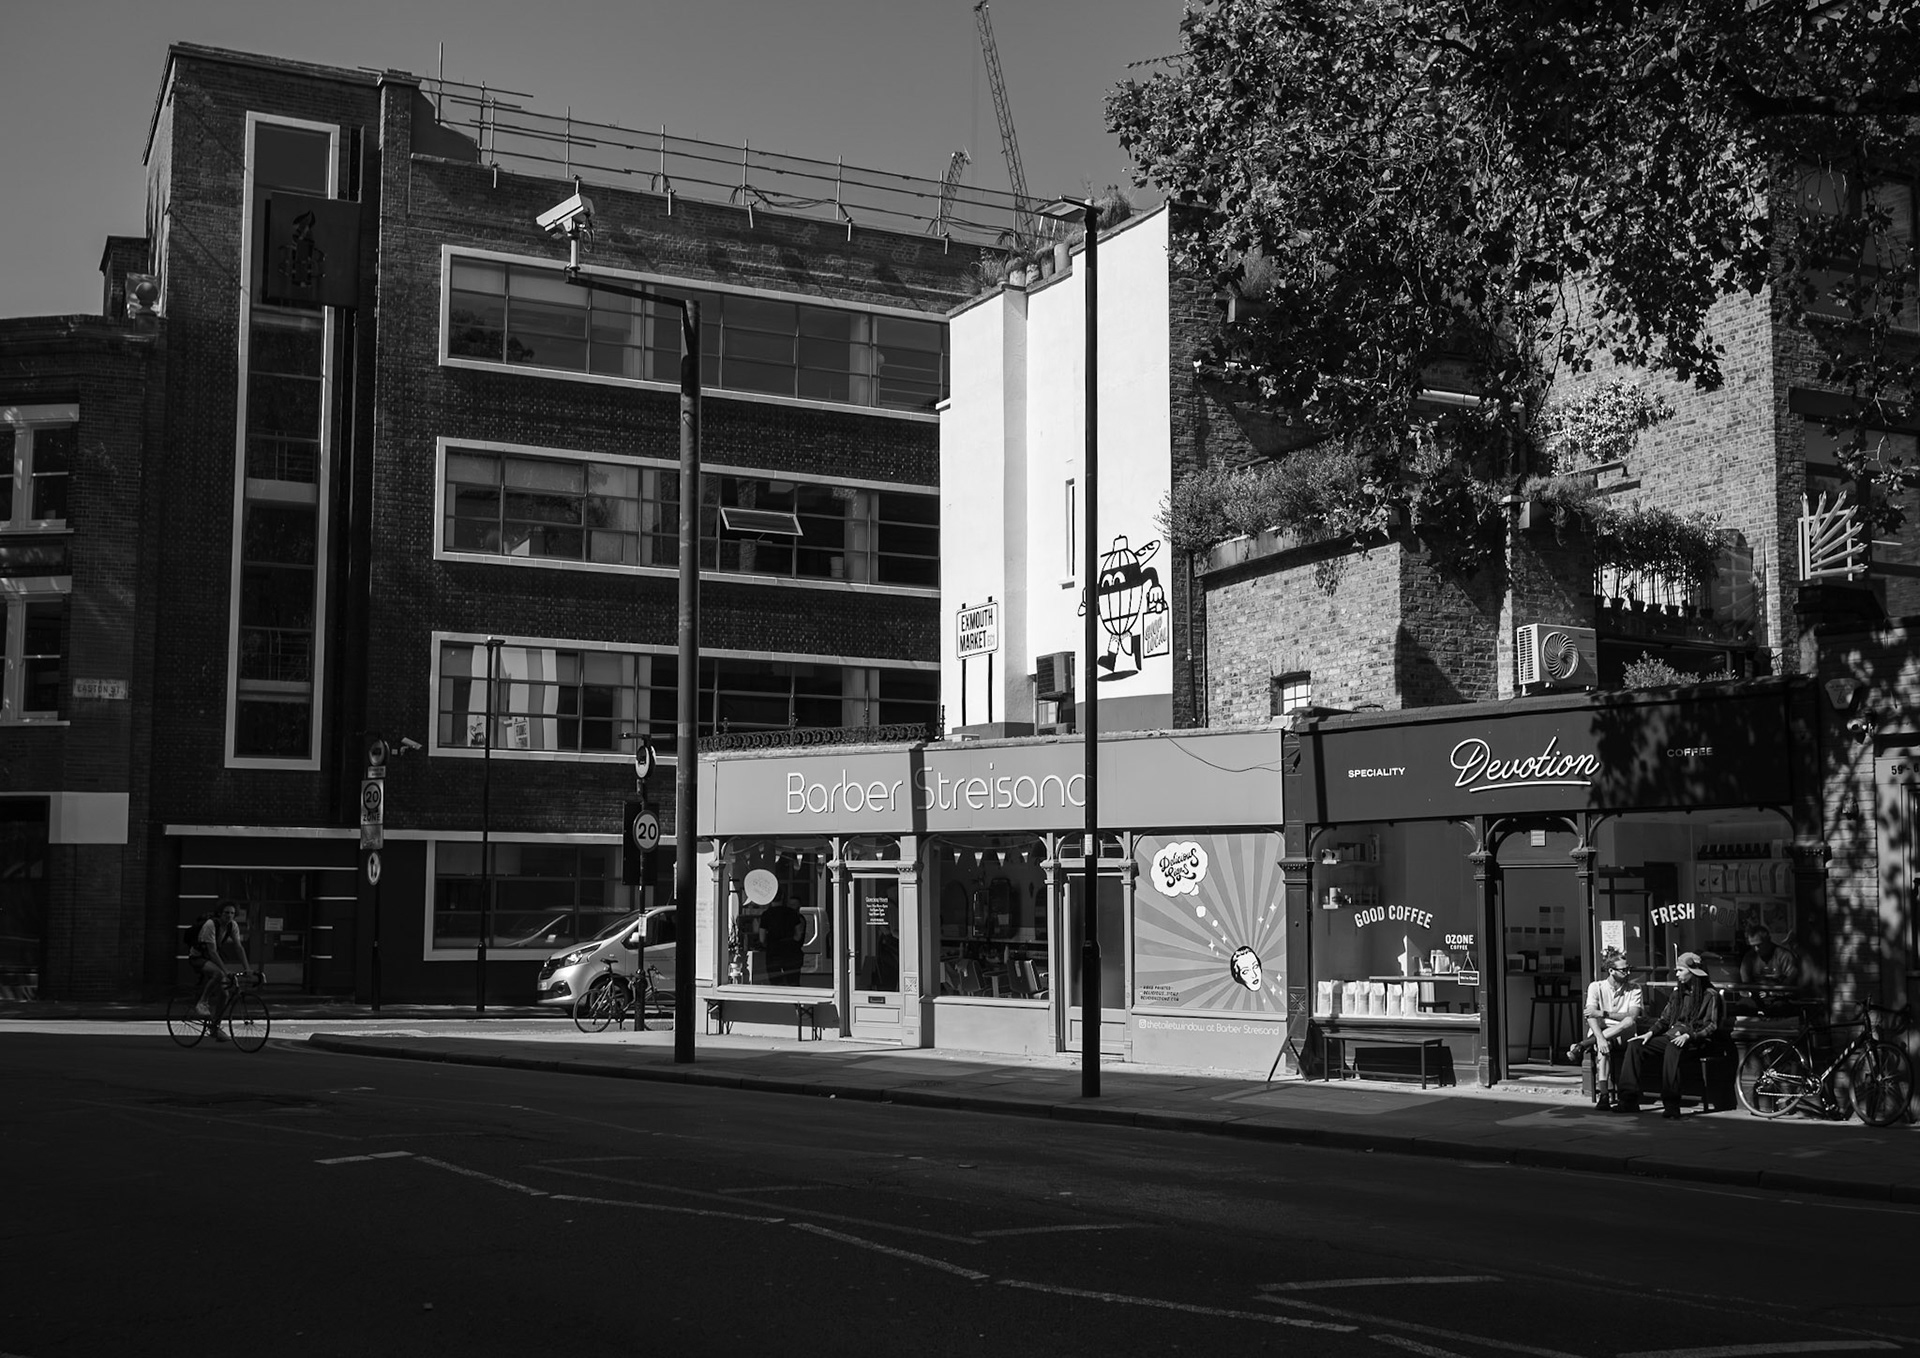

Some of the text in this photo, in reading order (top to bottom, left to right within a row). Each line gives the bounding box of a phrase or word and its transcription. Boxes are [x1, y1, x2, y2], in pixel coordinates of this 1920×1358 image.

[961, 608, 993, 632] EXMOUTH
[960, 630, 987, 652] MARKET
[1666, 747, 1713, 757] COFFEE
[1450, 736, 1600, 787] Devotion
[1348, 767, 1406, 778] SPECIALITY
[366, 791, 379, 803] 20
[787, 769, 903, 814] Barber
[363, 813, 380, 822] ZONE
[638, 822, 657, 840] 20
[1354, 904, 1434, 929] GOOD COFFEE
[1650, 902, 1696, 927] FRESH
[1445, 934, 1474, 945] OZONE
[1216, 1023, 1241, 1034] Barber
[1243, 1024, 1280, 1036] Streisand
